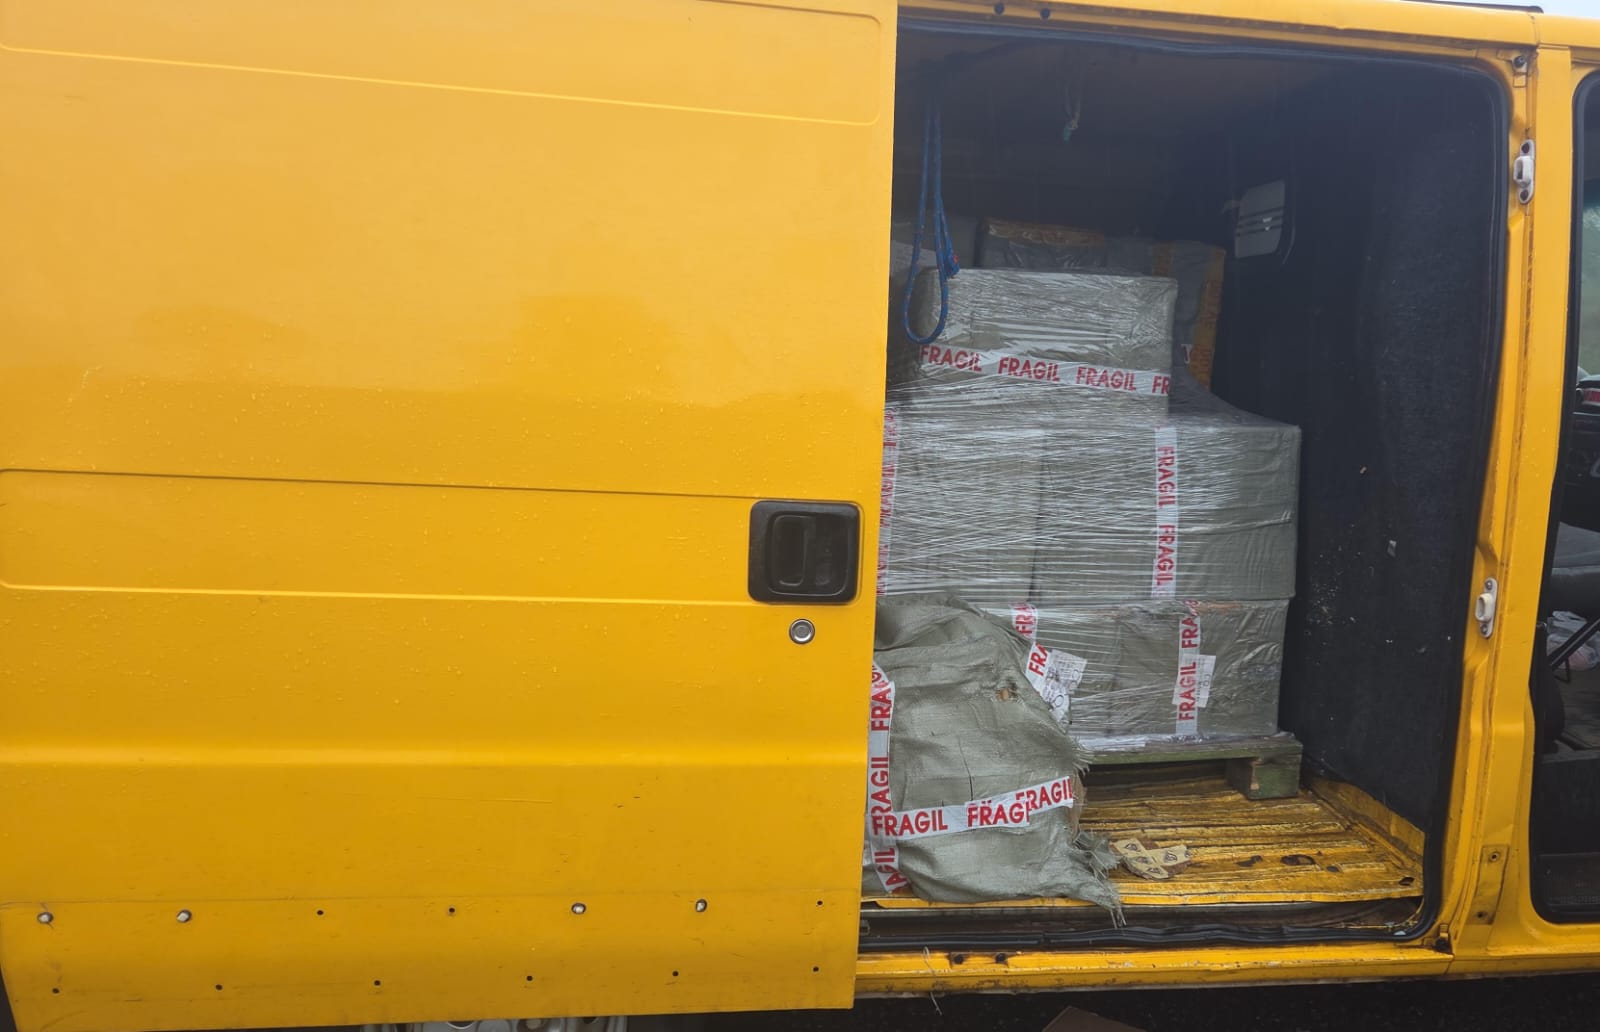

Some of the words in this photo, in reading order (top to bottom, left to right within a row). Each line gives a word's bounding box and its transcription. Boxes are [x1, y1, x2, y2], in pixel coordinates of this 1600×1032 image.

[919, 344, 983, 372] FRAGIL
[997, 356, 1061, 382] FRAGIL
[1075, 366, 1137, 392] FRAGIL
[1157, 446, 1176, 510] FRAGIL
[1155, 524, 1176, 586] FRAGIL
[1177, 661, 1197, 721] FRAGIL
[871, 809, 948, 837] FRAGIL
